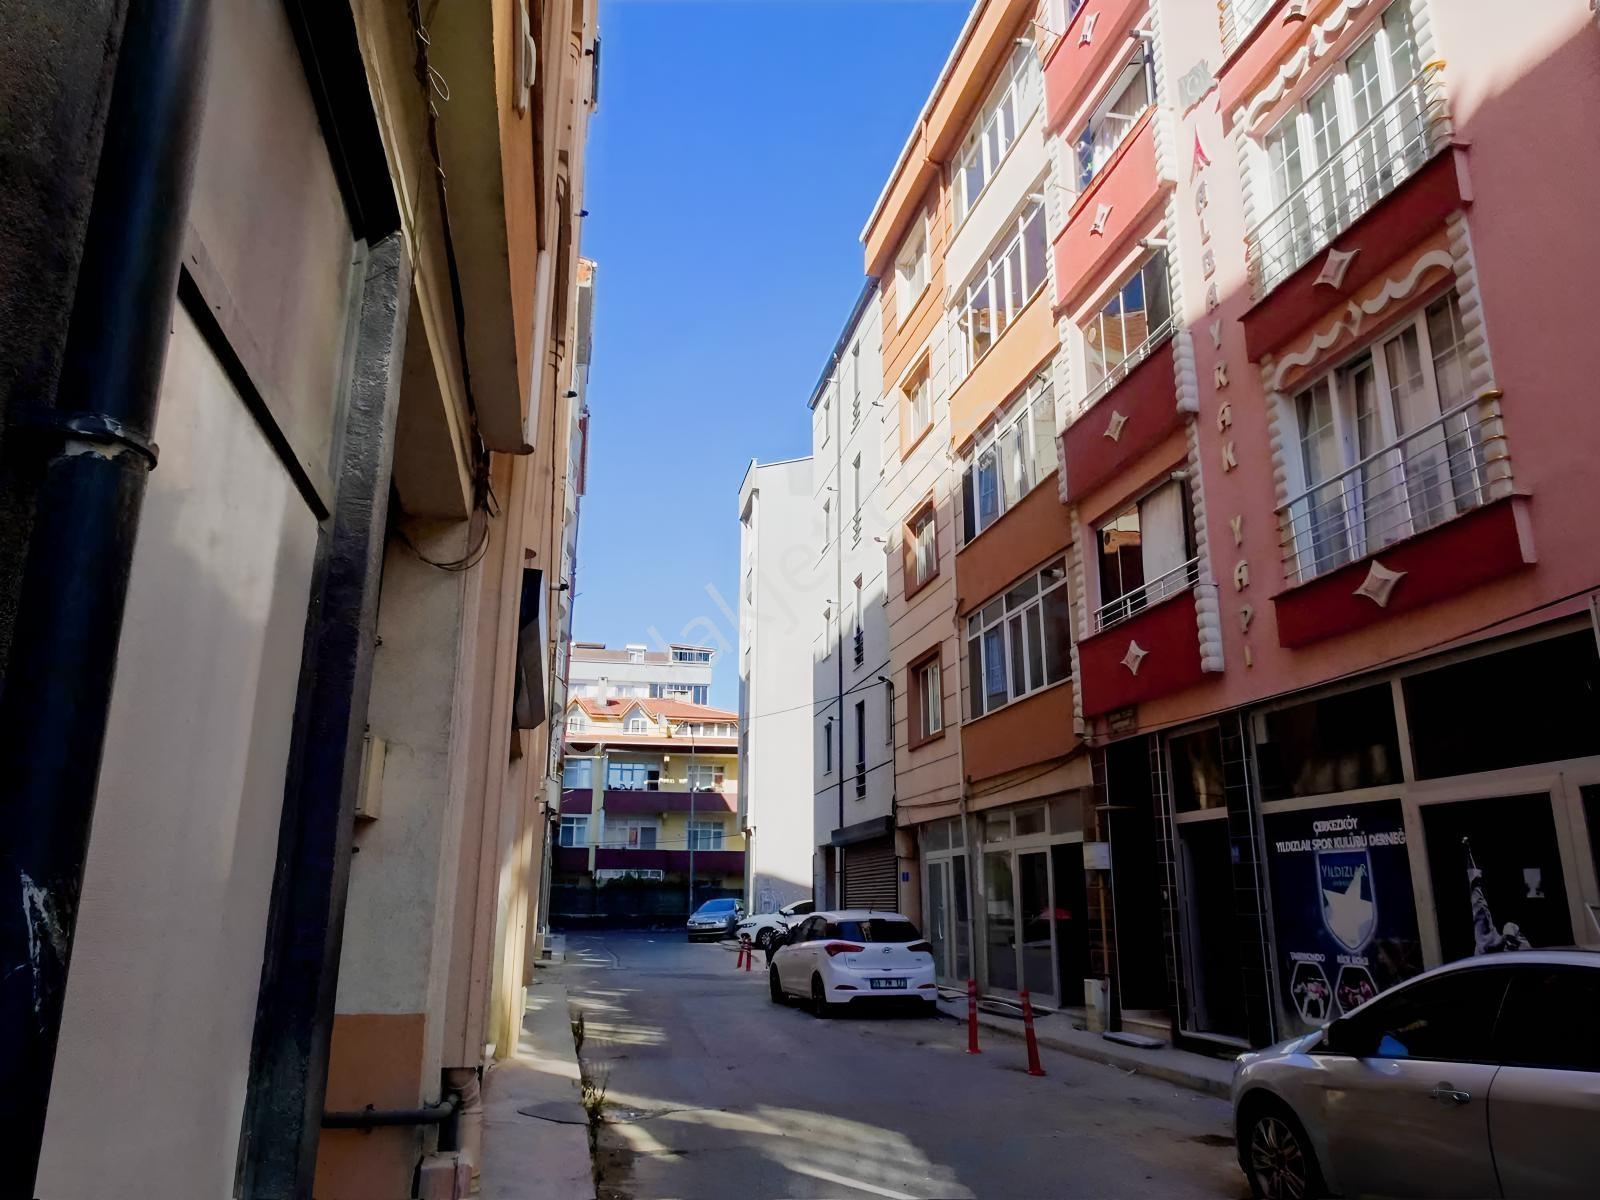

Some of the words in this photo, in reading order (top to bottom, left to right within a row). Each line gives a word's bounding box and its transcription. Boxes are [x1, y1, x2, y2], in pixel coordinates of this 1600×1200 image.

[1195, 180, 1238, 472] ALBAYRAK
[1230, 514, 1253, 668] YAPI
[1312, 838, 1333, 850] SPOR
